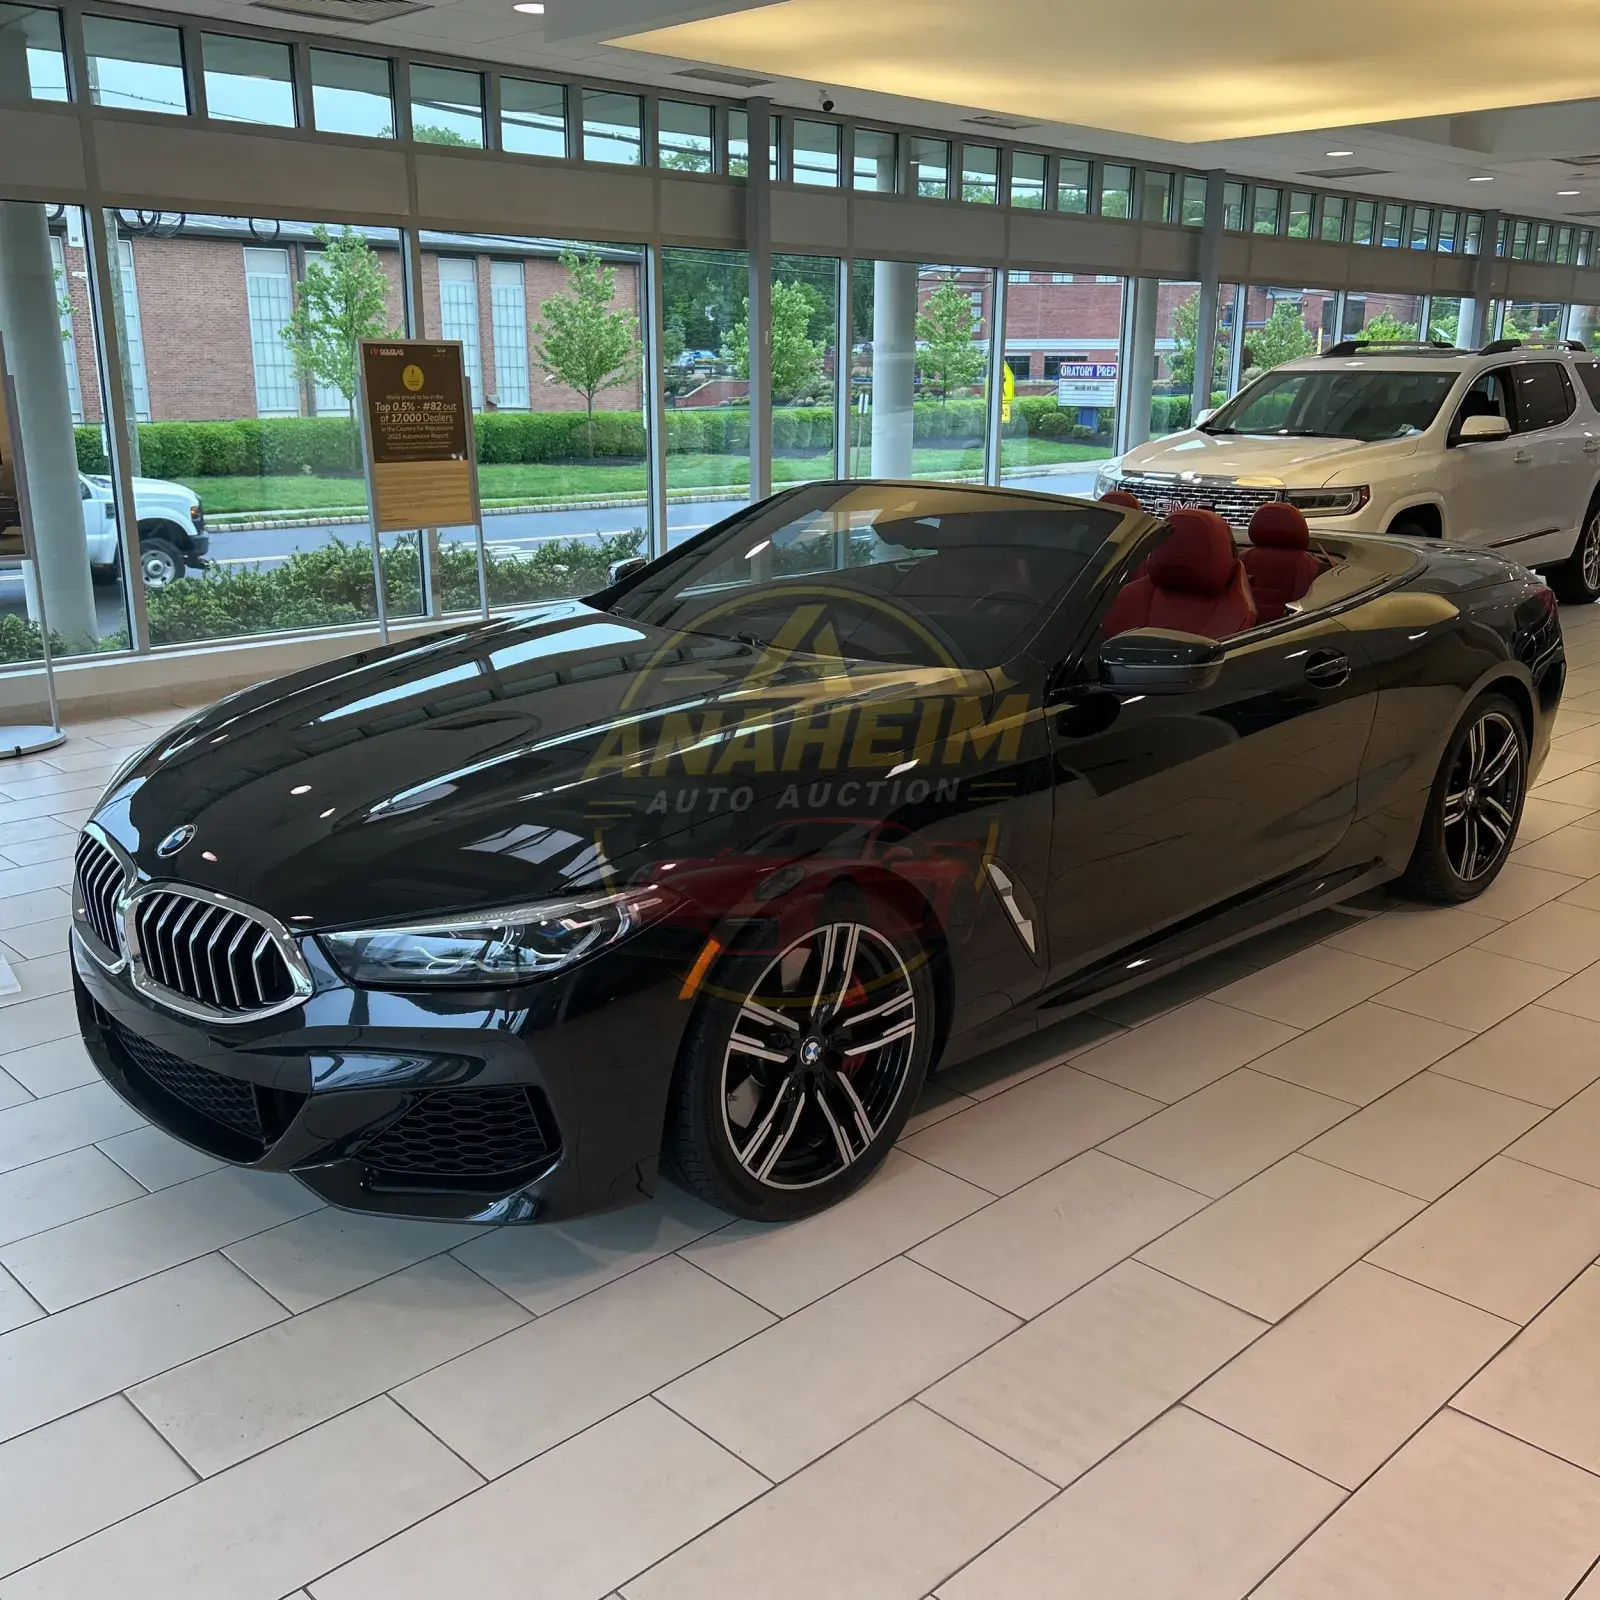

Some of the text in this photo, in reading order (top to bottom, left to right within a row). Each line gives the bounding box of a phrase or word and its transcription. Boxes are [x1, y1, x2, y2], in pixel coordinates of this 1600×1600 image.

[380, 348, 404, 356] DOUGLAS
[1061, 365, 1116, 376] ORATORY PREP
[375, 402, 390, 412] Top
[393, 402, 415, 411] 0.5%
[422, 402, 441, 411] #82
[443, 402, 456, 410] out
[381, 413, 453, 423] of 17,000 Dealers
[1154, 499, 1213, 512] GMC
